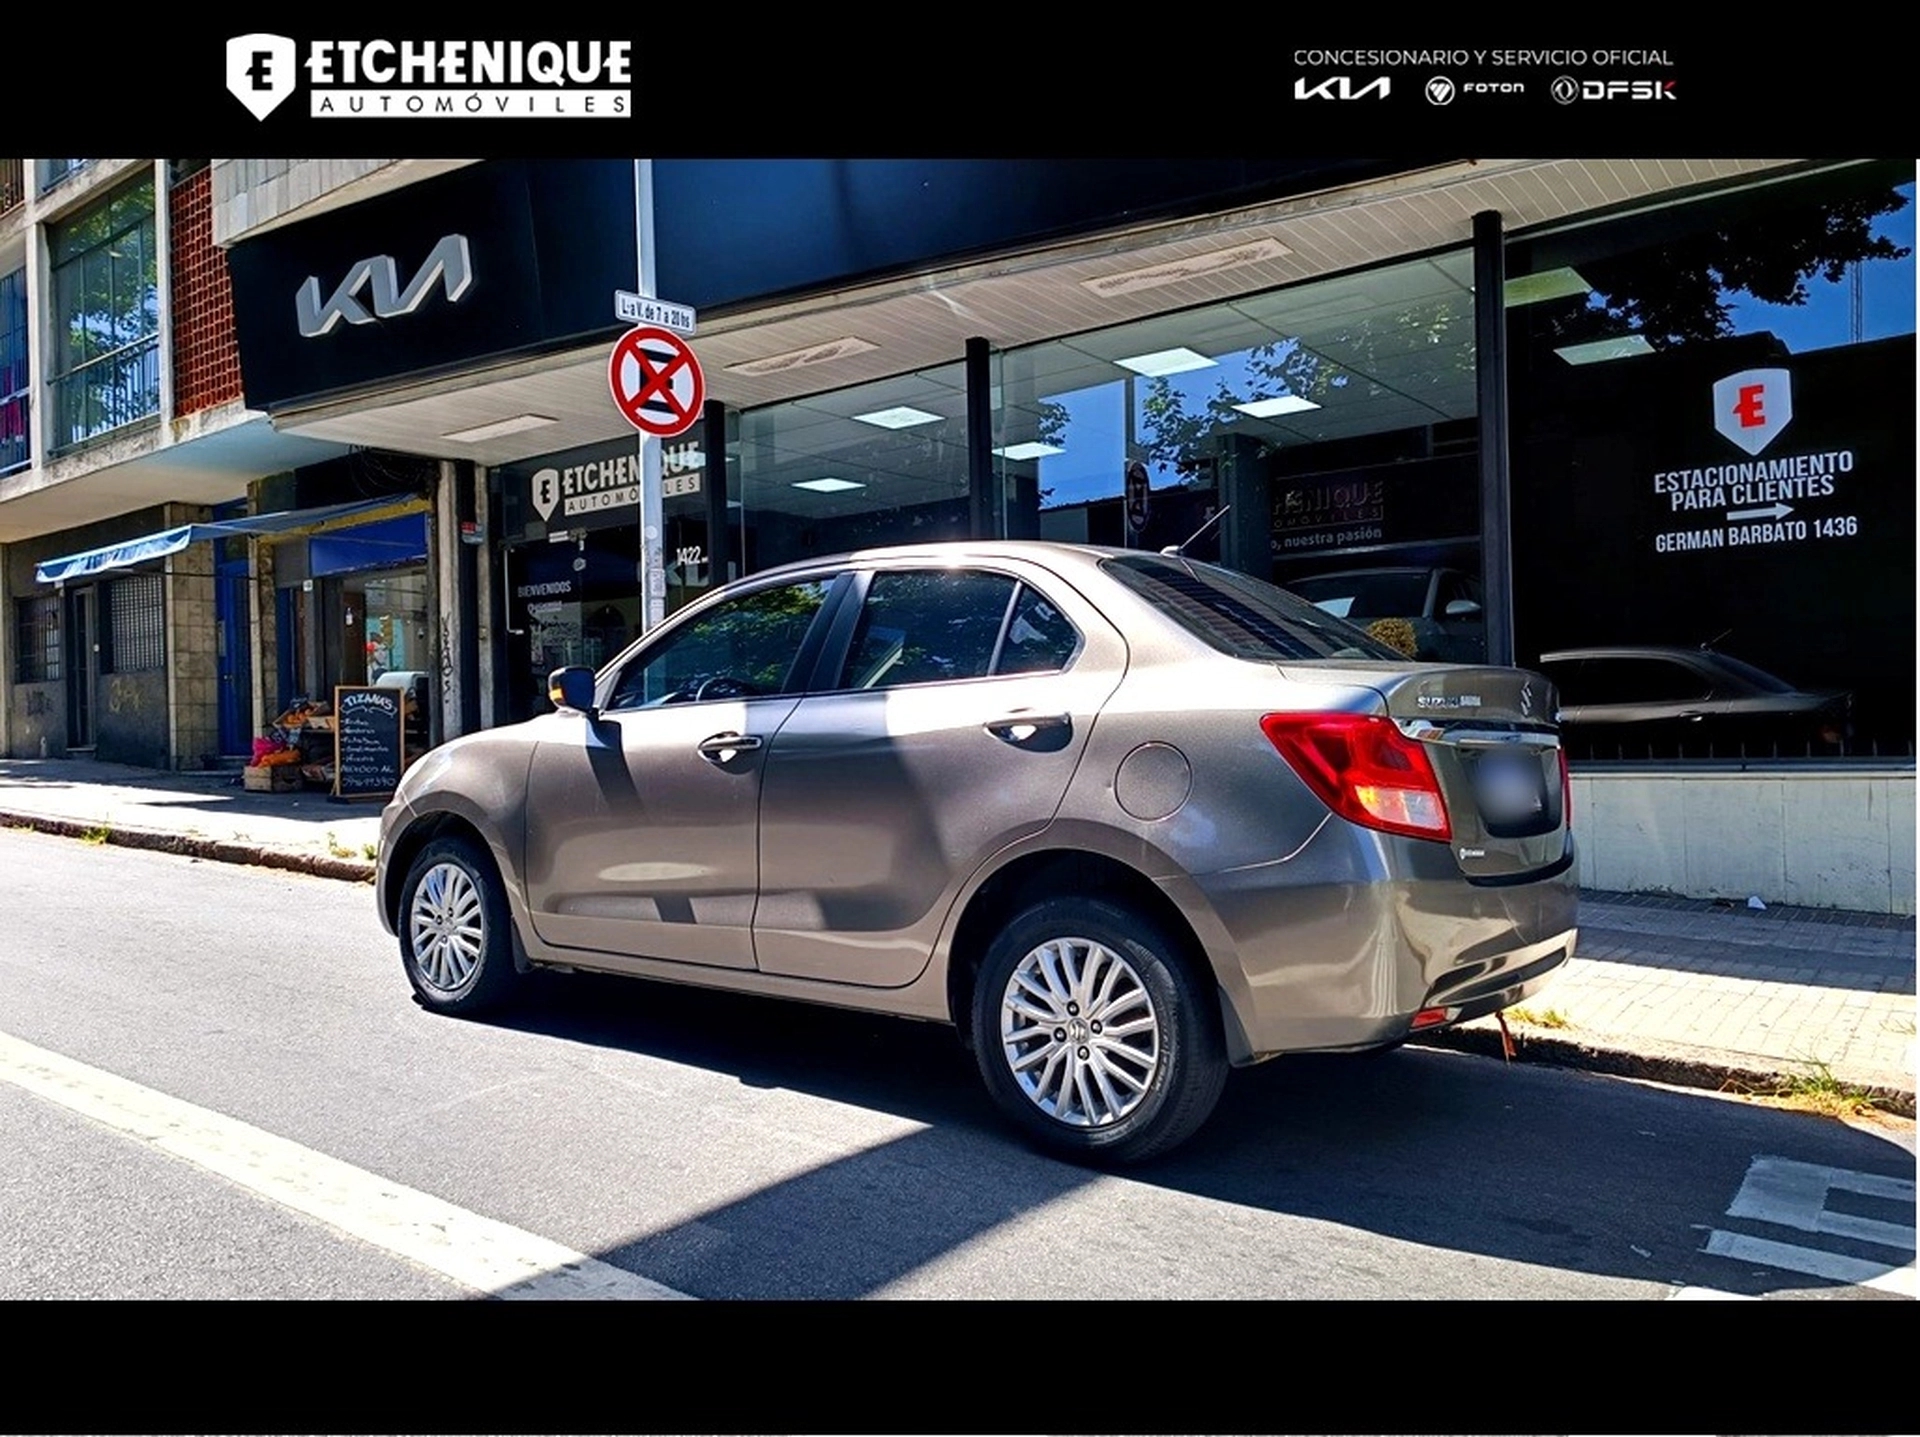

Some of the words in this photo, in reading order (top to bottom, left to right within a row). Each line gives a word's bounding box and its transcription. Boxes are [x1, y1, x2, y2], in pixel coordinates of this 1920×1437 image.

[295, 233, 472, 338] KIA
[645, 304, 655, 321] de
[656, 306, 662, 322] 7
[663, 312, 669, 324] a
[681, 312, 690, 329] hs
[1654, 450, 1854, 494] ESTACIONAMIENTO
[1671, 487, 1726, 512] PARA
[1731, 474, 1835, 506] CLIENTES
[1284, 532, 1334, 547] nuestra
[1336, 525, 1382, 545] pasión
[1655, 527, 1724, 553] GERMAN
[1728, 520, 1807, 546] BARBATO
[1813, 516, 1858, 539] 1436
[676, 545, 701, 566] 1422
